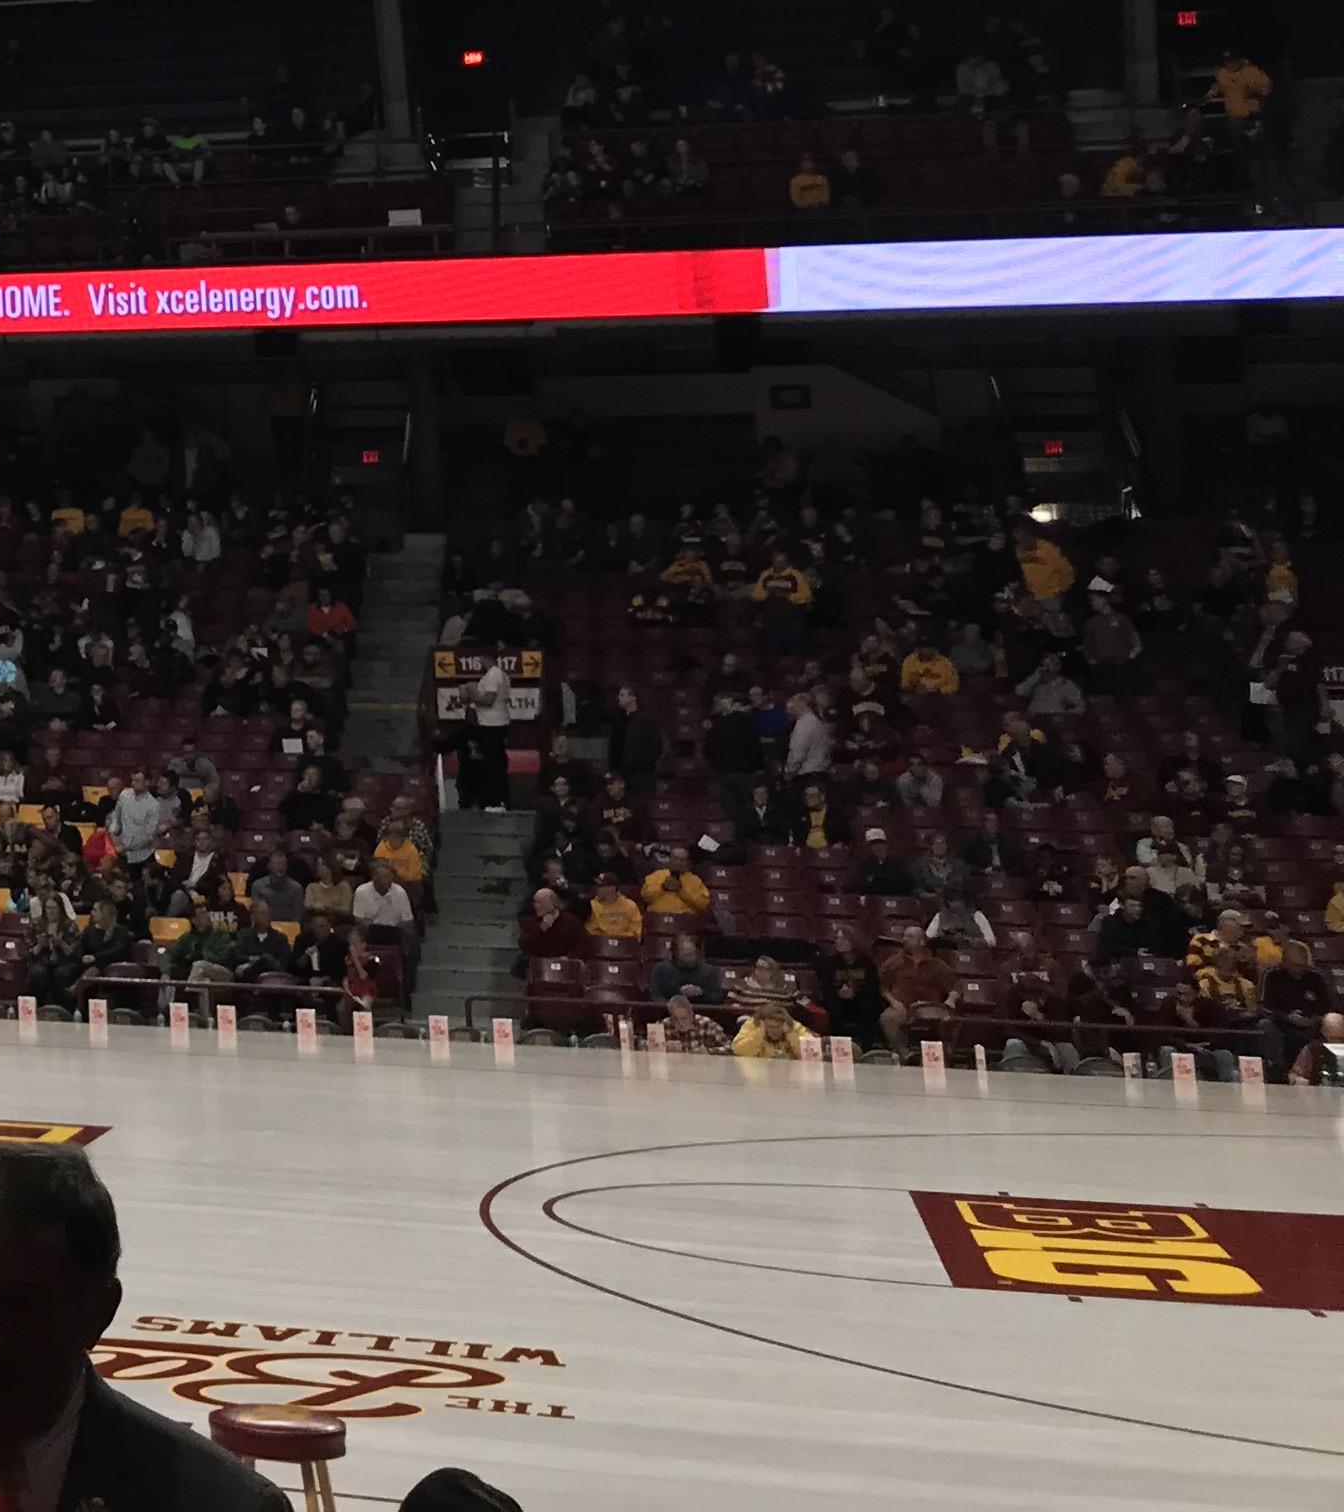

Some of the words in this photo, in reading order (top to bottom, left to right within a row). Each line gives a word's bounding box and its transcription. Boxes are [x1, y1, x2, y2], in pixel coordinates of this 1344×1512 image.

[89, 283, 149, 316] Visit
[155, 281, 370, 322] xcelenergy.com.
[134, 1314, 568, 1368] WILLIAMS
[445, 1393, 576, 1420] THE
